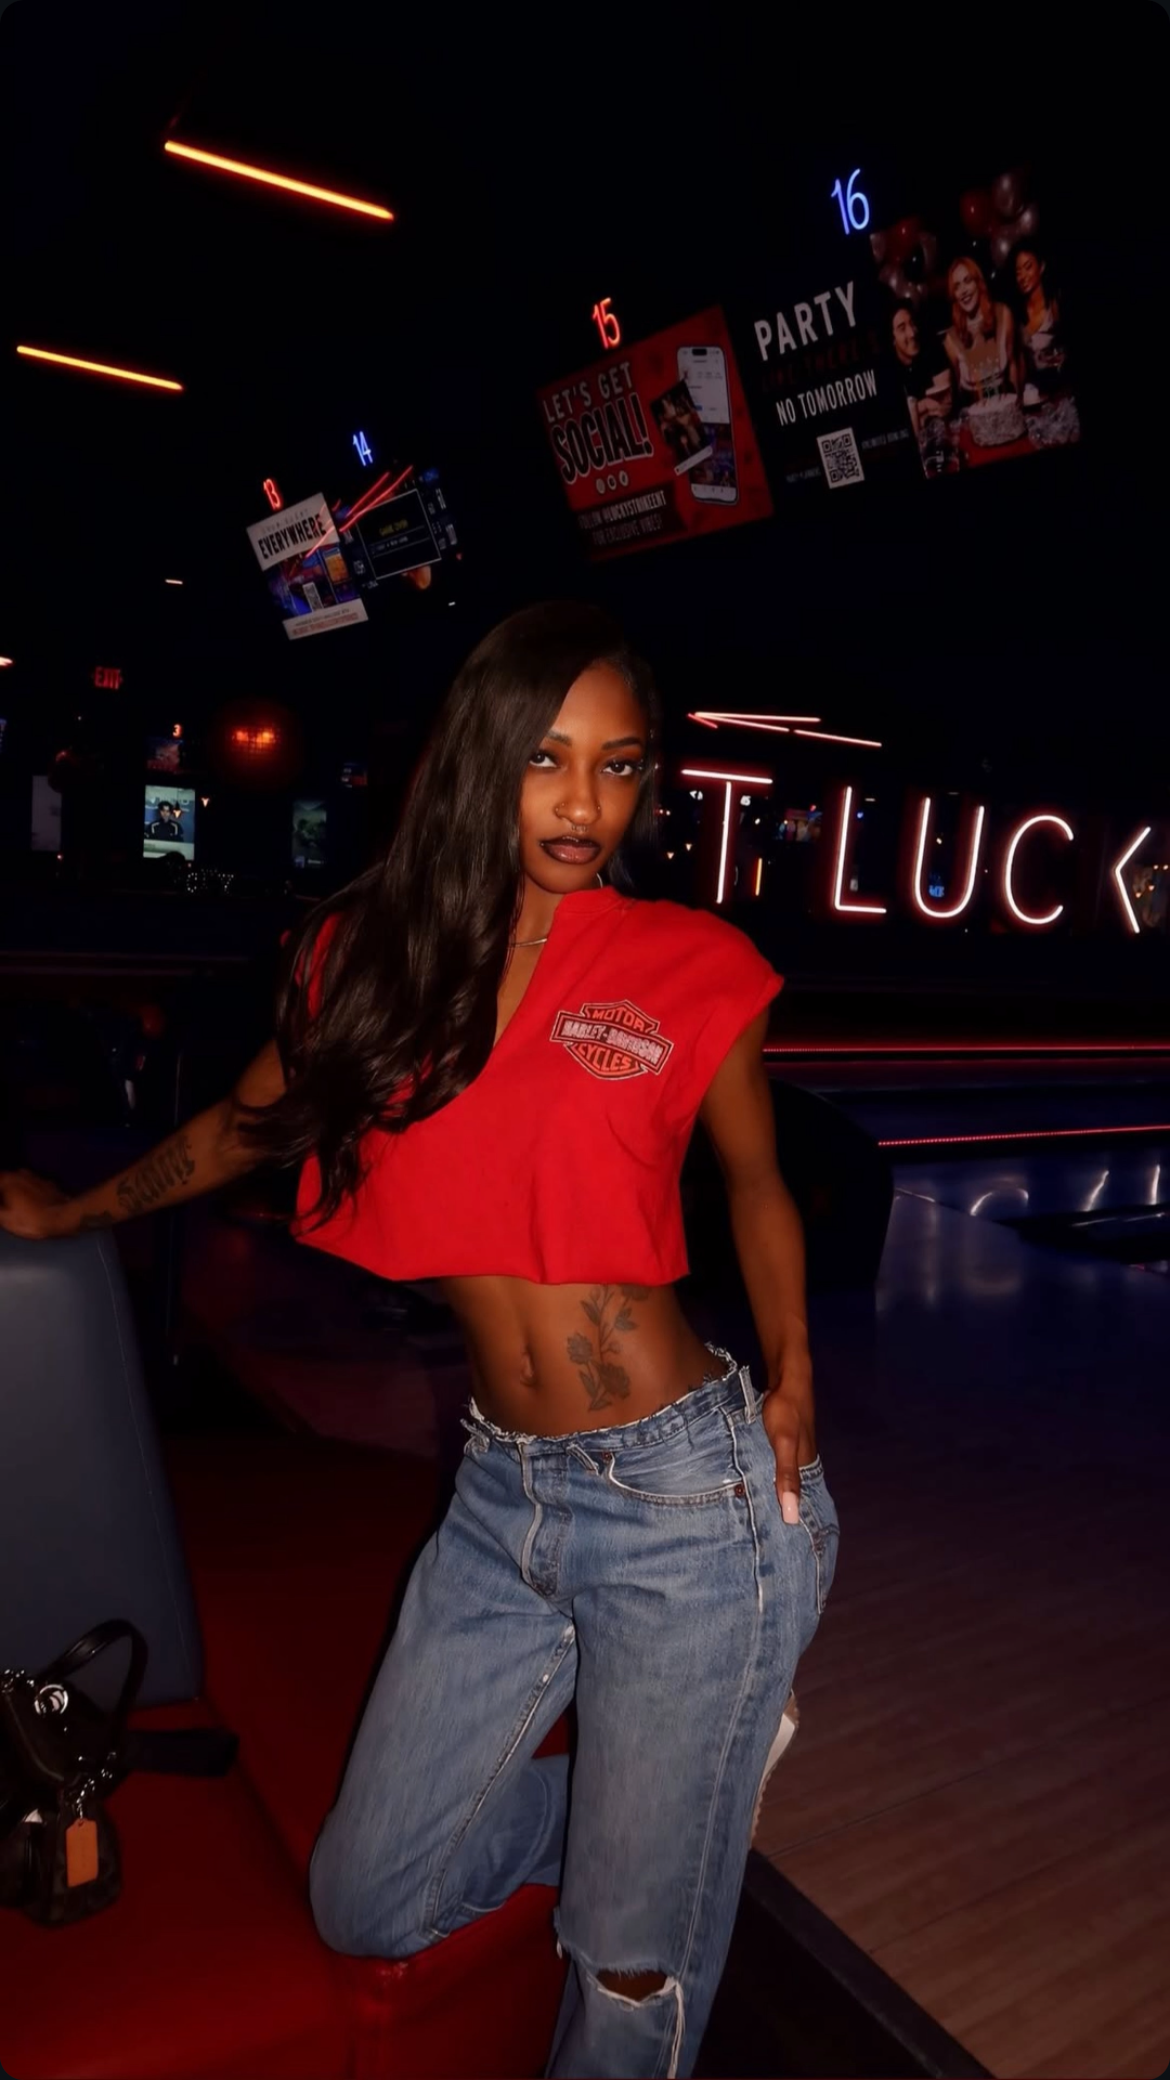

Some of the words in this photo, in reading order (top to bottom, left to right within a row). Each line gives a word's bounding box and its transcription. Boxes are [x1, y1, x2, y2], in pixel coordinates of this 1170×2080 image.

[831, 168, 870, 235] 16
[592, 297, 622, 348] 15
[754, 281, 857, 361] PARTY
[543, 381, 592, 423] LET'S
[598, 361, 634, 398] GET
[776, 398, 796, 426] NO
[798, 369, 878, 420] TOMORROW
[352, 431, 374, 467] 14
[550, 392, 654, 484] SOCIAL!
[258, 513, 327, 559] EVERYWHERE
[94, 666, 121, 690] EXIT
[173, 723, 184, 739] 3
[833, 785, 1152, 935] LUCK
[560, 1020, 664, 1064] HARLEY-DAVIDSON
[592, 1006, 646, 1033] MOTOR
[577, 1043, 632, 1072] CYCLES
